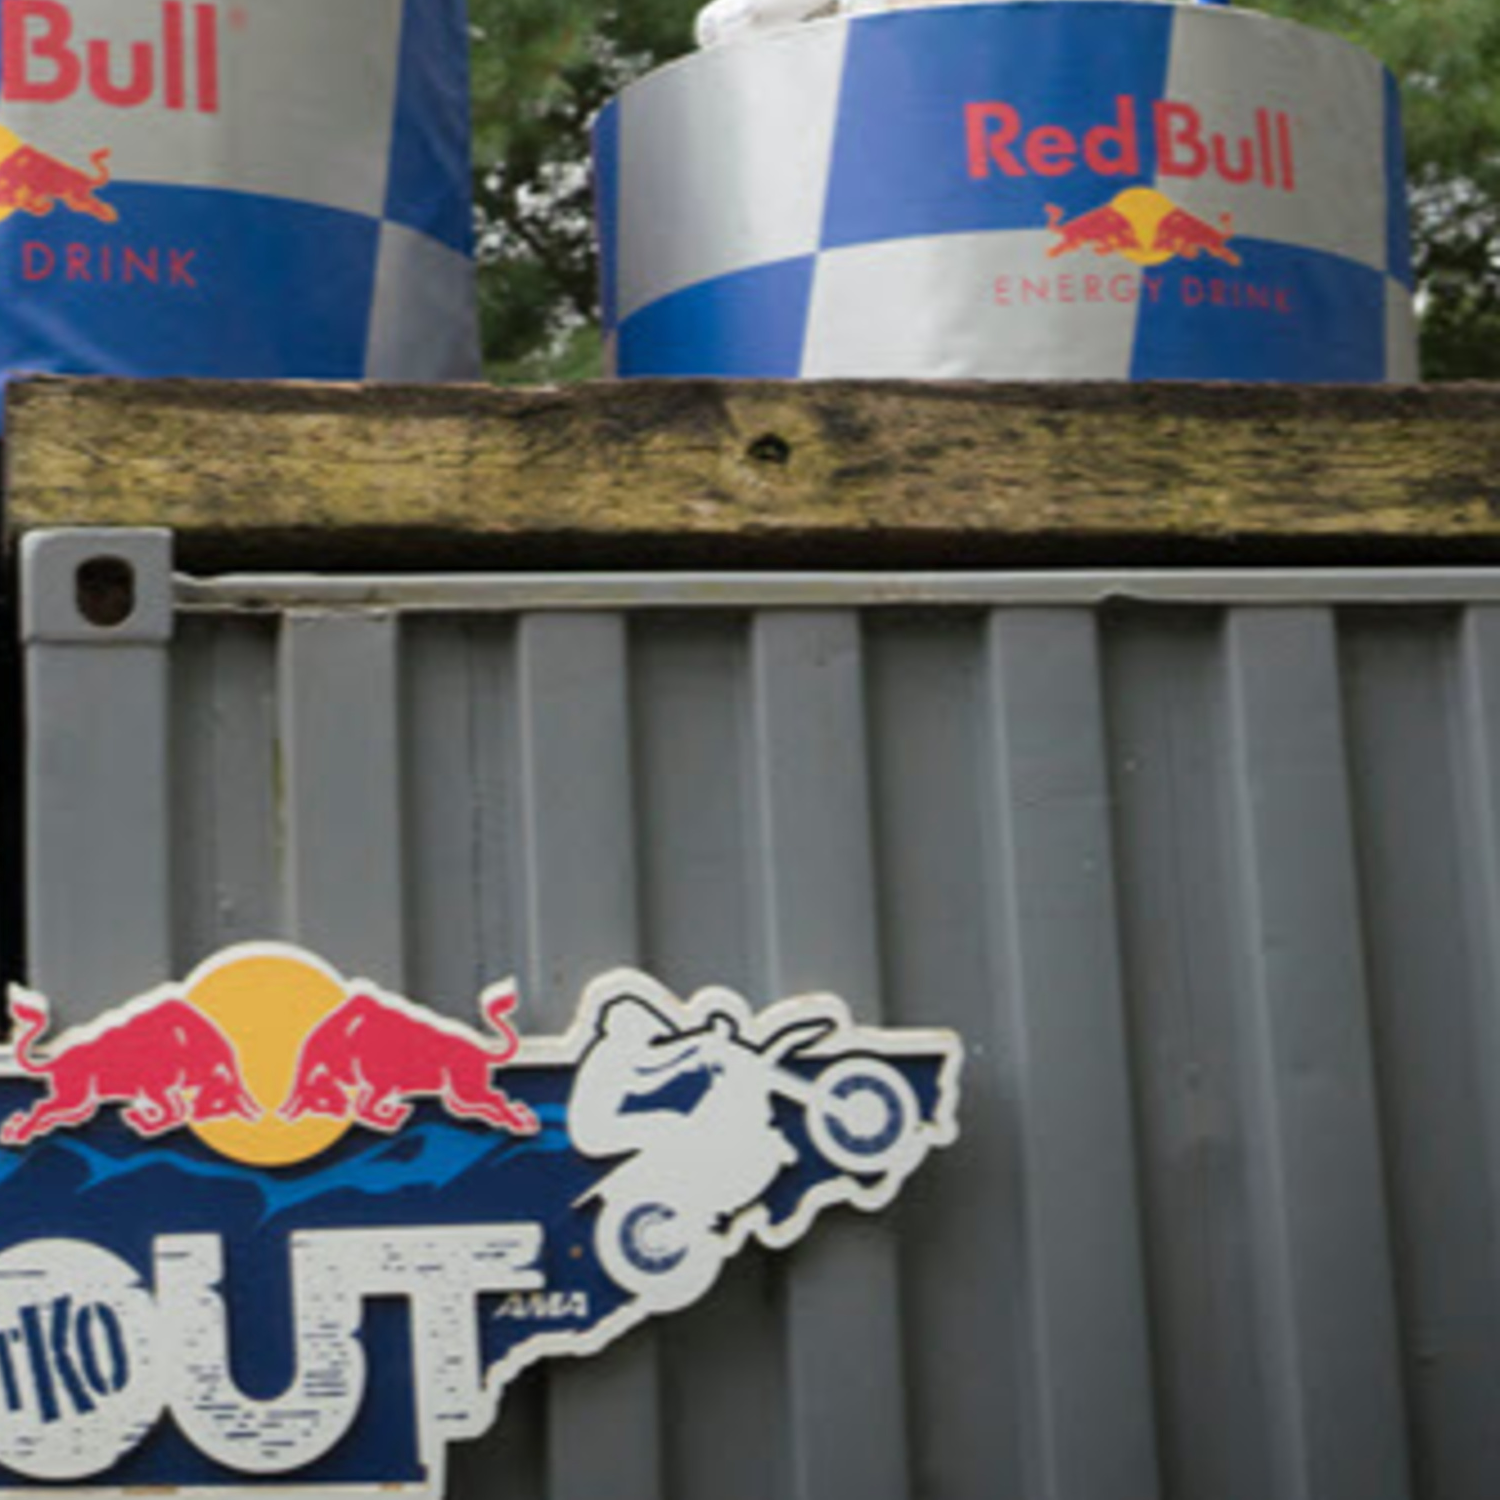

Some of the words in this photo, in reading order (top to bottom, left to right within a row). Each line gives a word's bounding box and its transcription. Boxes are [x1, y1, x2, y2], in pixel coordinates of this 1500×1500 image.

[963, 94, 1139, 179] Red
[1153, 99, 1295, 192] Bull
[23, 241, 197, 287] DRINK
[994, 273, 1164, 307] ENERGY
[1182, 277, 1296, 314] DRINK
